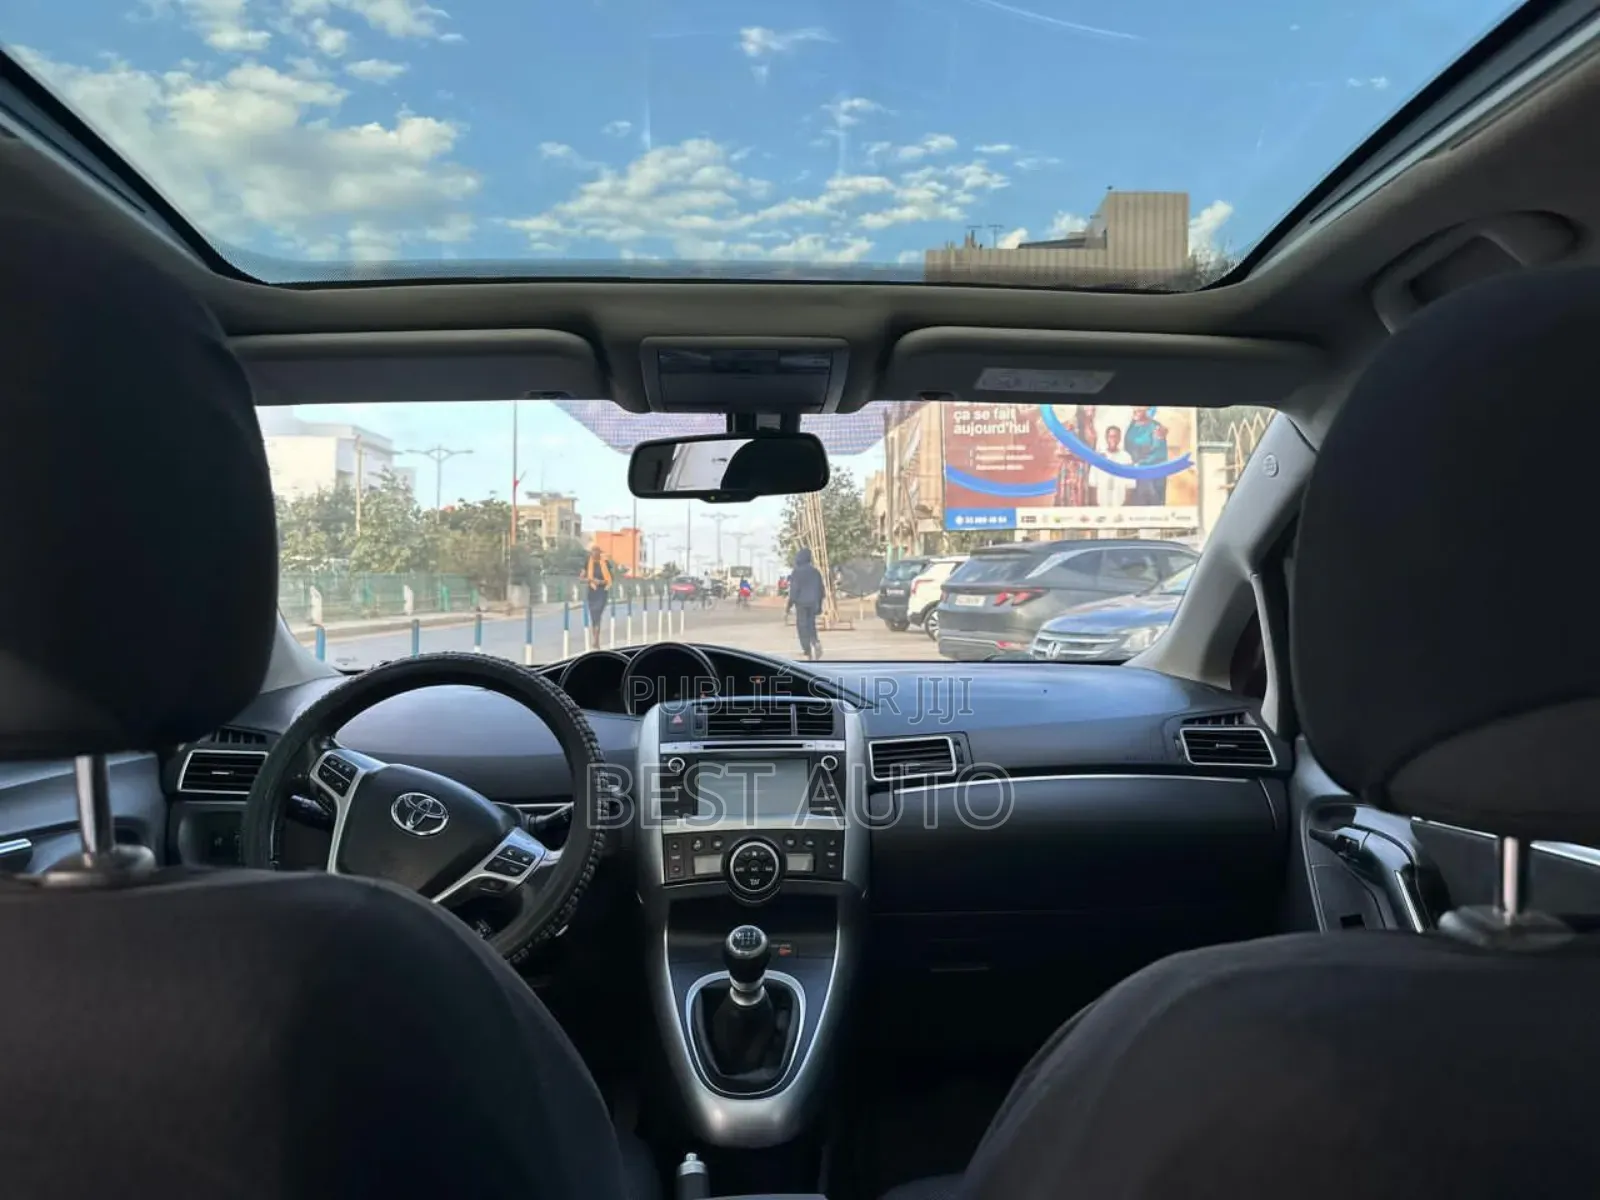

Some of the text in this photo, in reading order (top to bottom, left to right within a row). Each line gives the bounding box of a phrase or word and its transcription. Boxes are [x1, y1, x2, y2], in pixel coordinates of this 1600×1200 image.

[953, 407, 1016, 423] ça se fait
